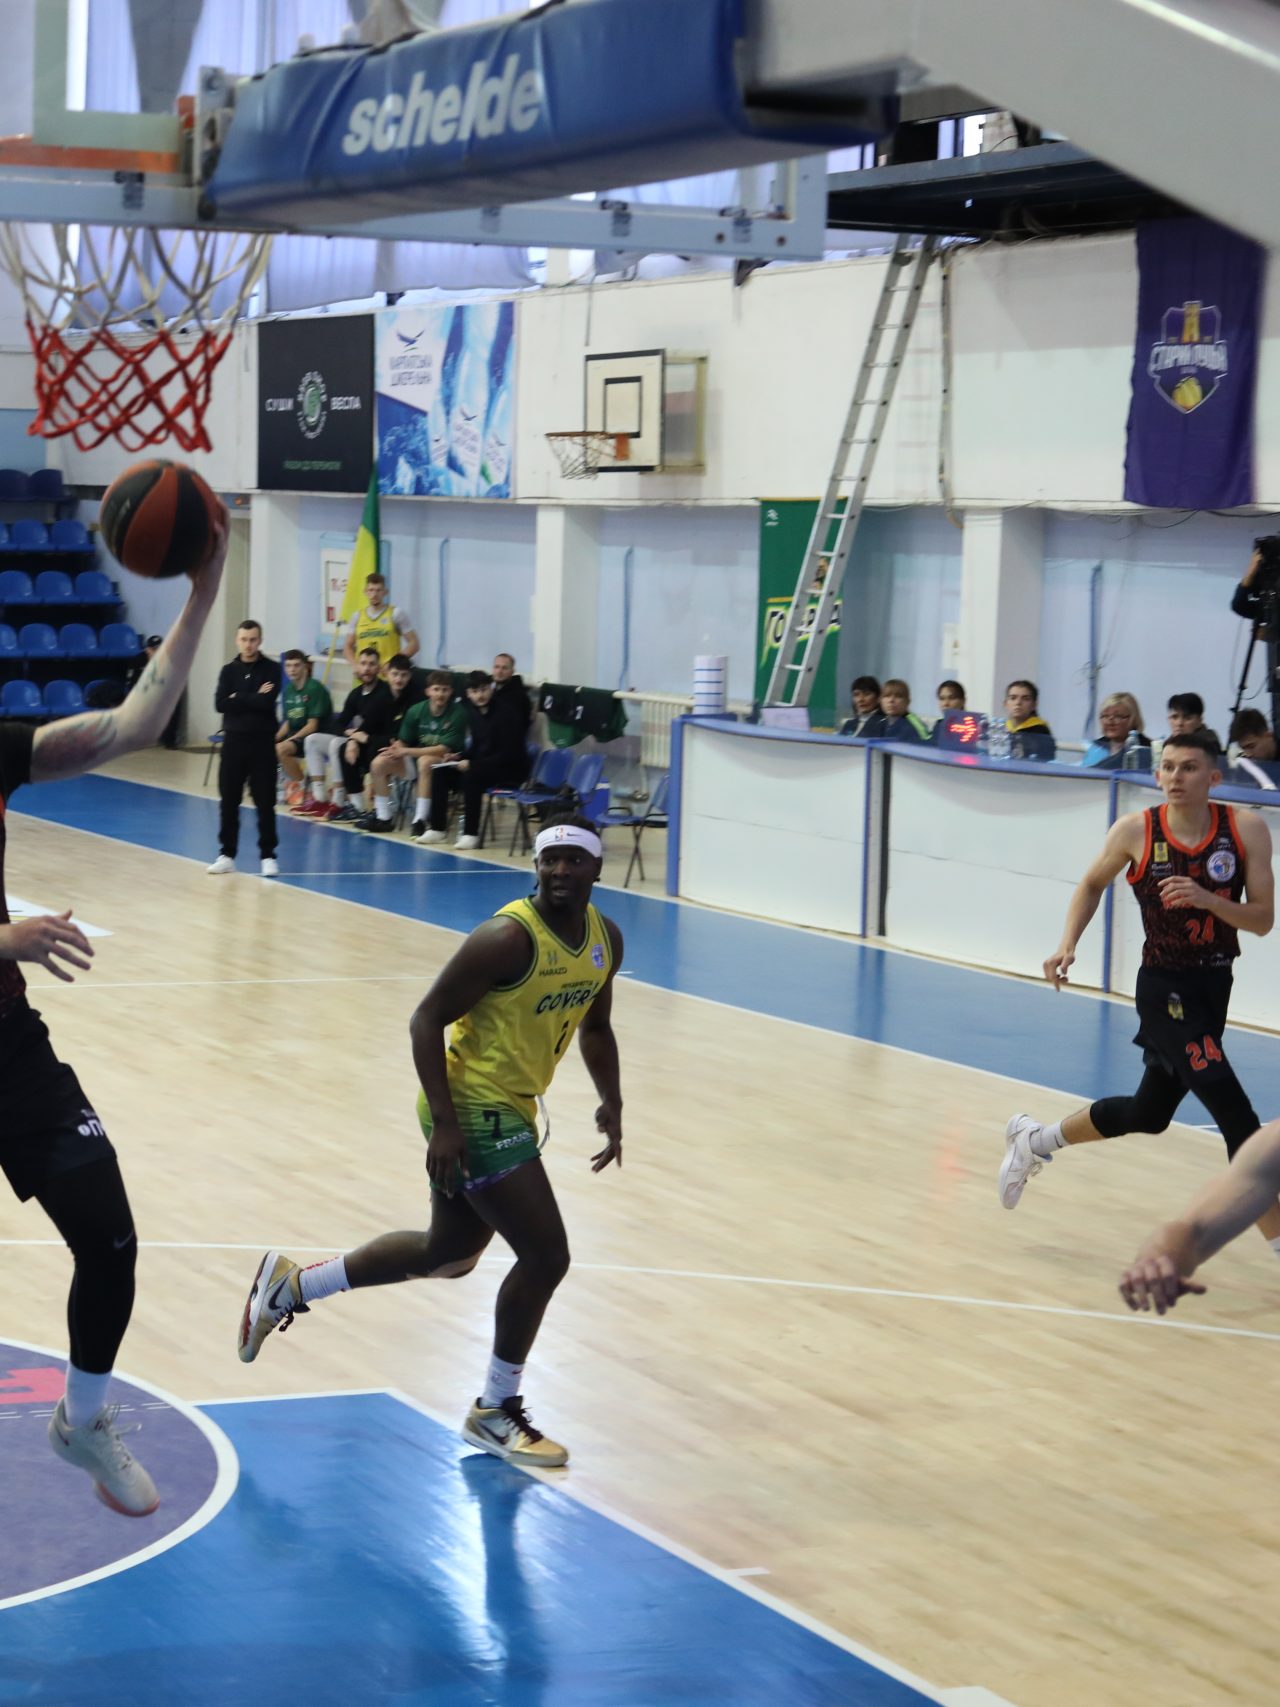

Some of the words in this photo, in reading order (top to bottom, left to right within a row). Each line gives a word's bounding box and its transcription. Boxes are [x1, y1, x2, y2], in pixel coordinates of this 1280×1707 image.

[341, 52, 543, 157] schelde
[1185, 1033, 1223, 1073] 24
[482, 1109, 503, 1139] 7
